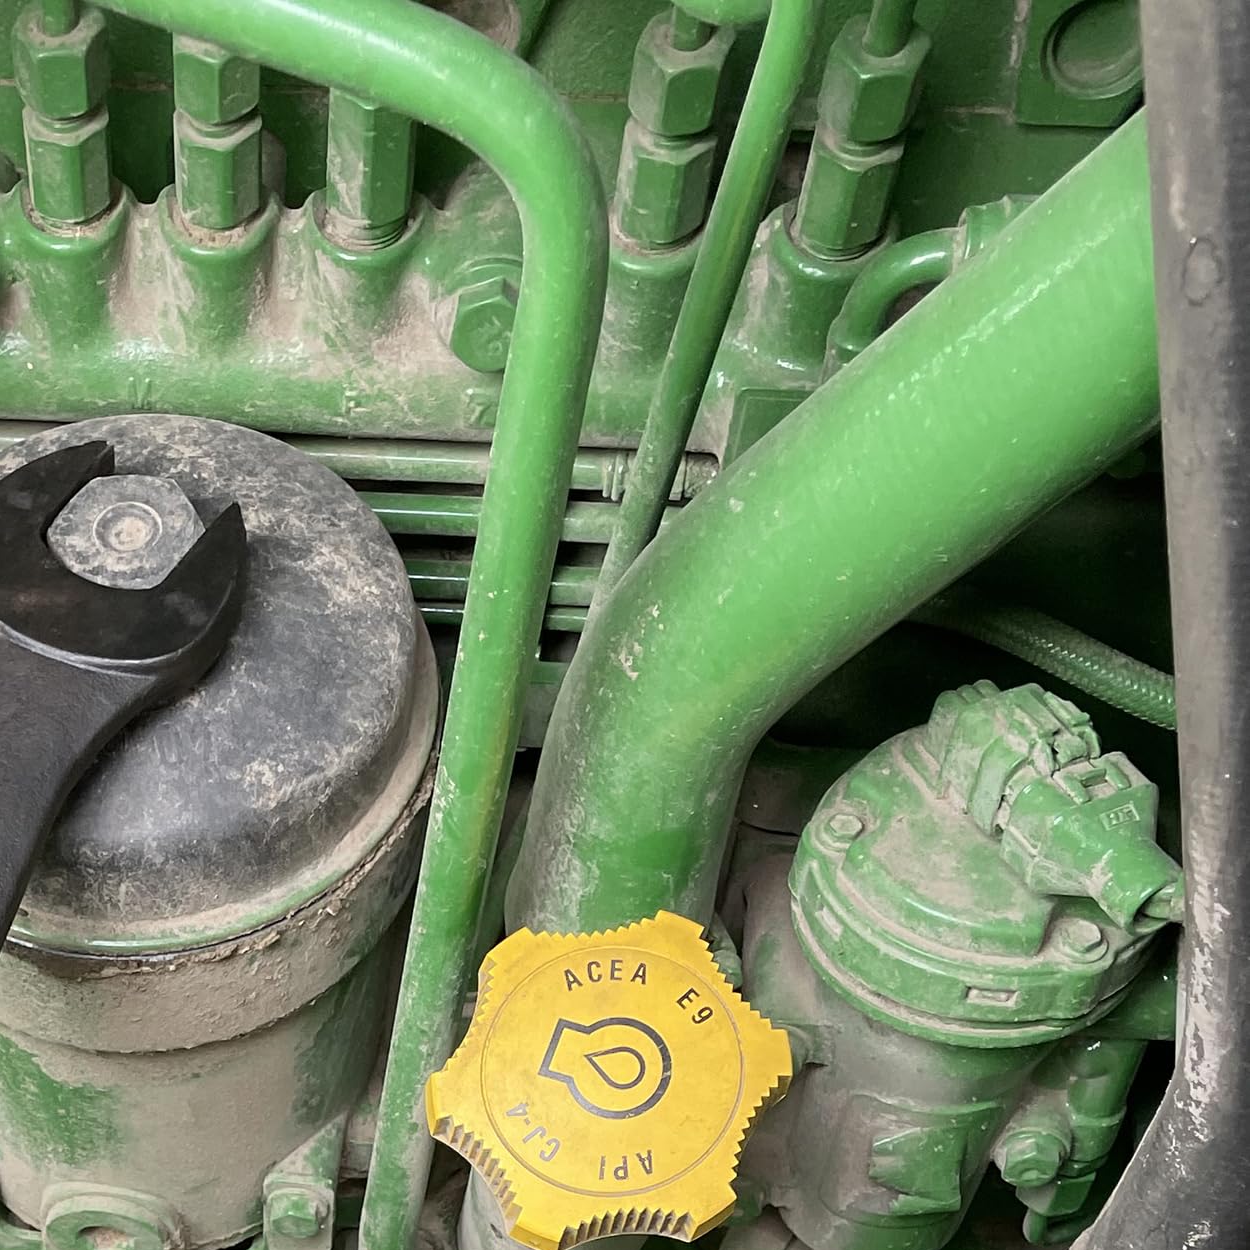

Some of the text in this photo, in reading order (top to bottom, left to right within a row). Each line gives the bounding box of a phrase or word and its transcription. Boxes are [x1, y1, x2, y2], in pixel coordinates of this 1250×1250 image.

[564, 959, 714, 1025] ACEA E9
[505, 1102, 653, 1180] API CJ-4
